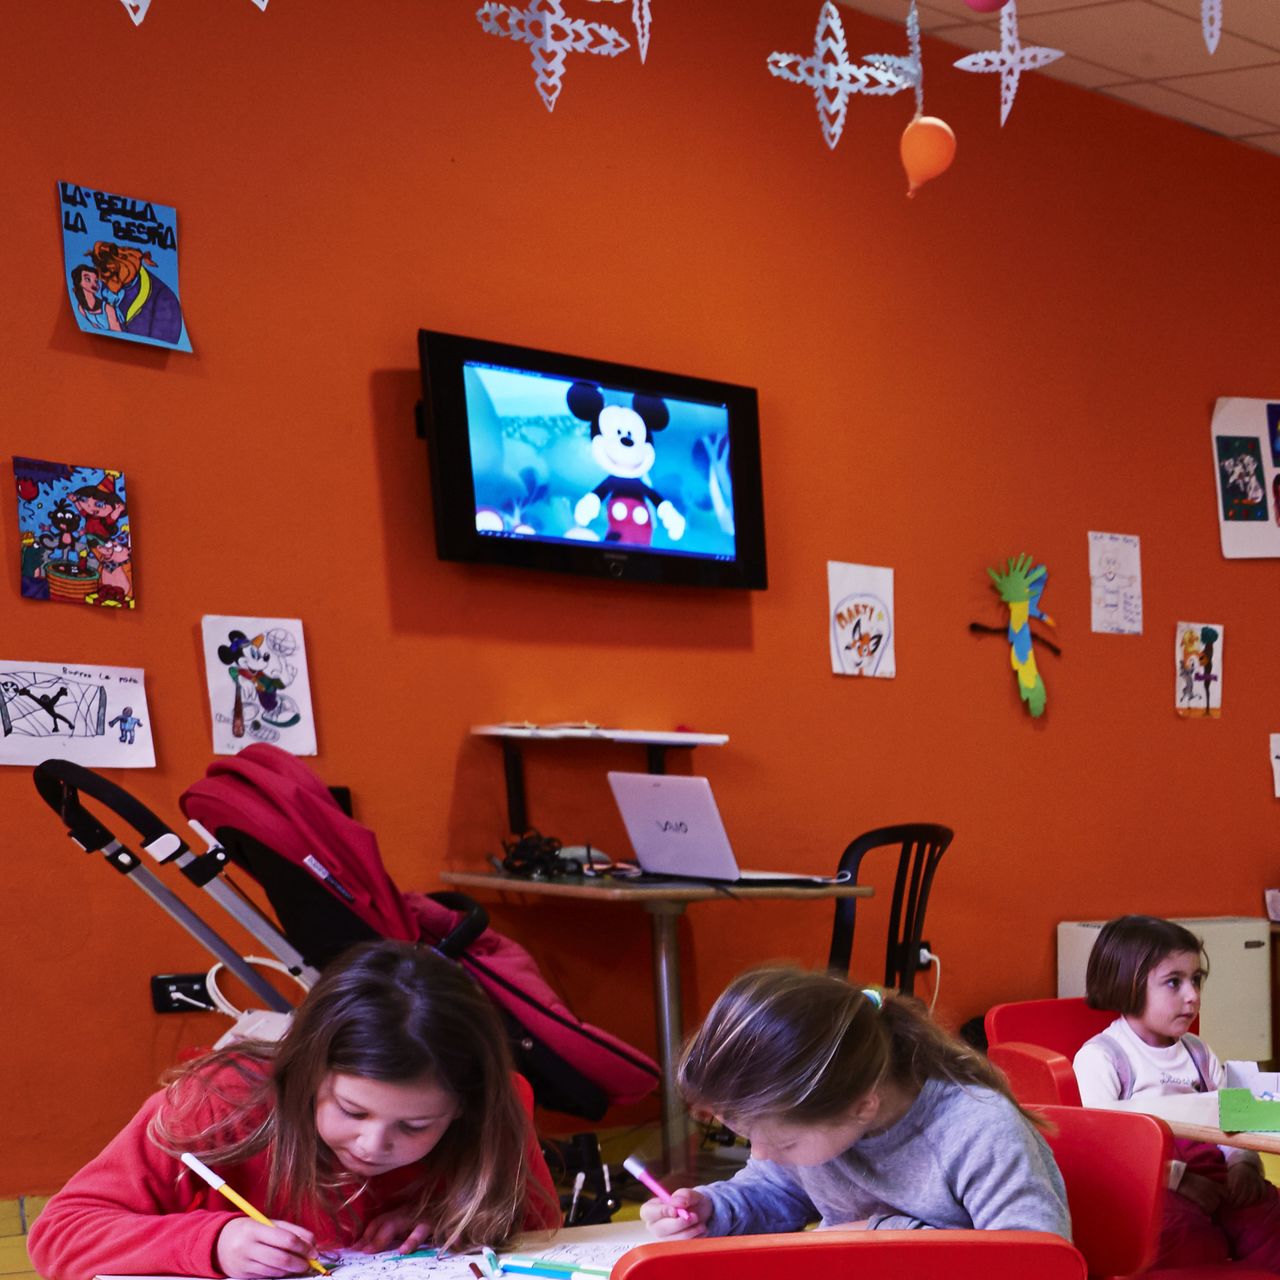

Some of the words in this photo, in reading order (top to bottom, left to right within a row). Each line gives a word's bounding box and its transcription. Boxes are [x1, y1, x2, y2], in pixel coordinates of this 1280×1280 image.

[61, 182, 88, 208] LA
[94, 190, 158, 223] BELLA
[64, 211, 87, 234] LA
[112, 220, 176, 252] BESTIA
